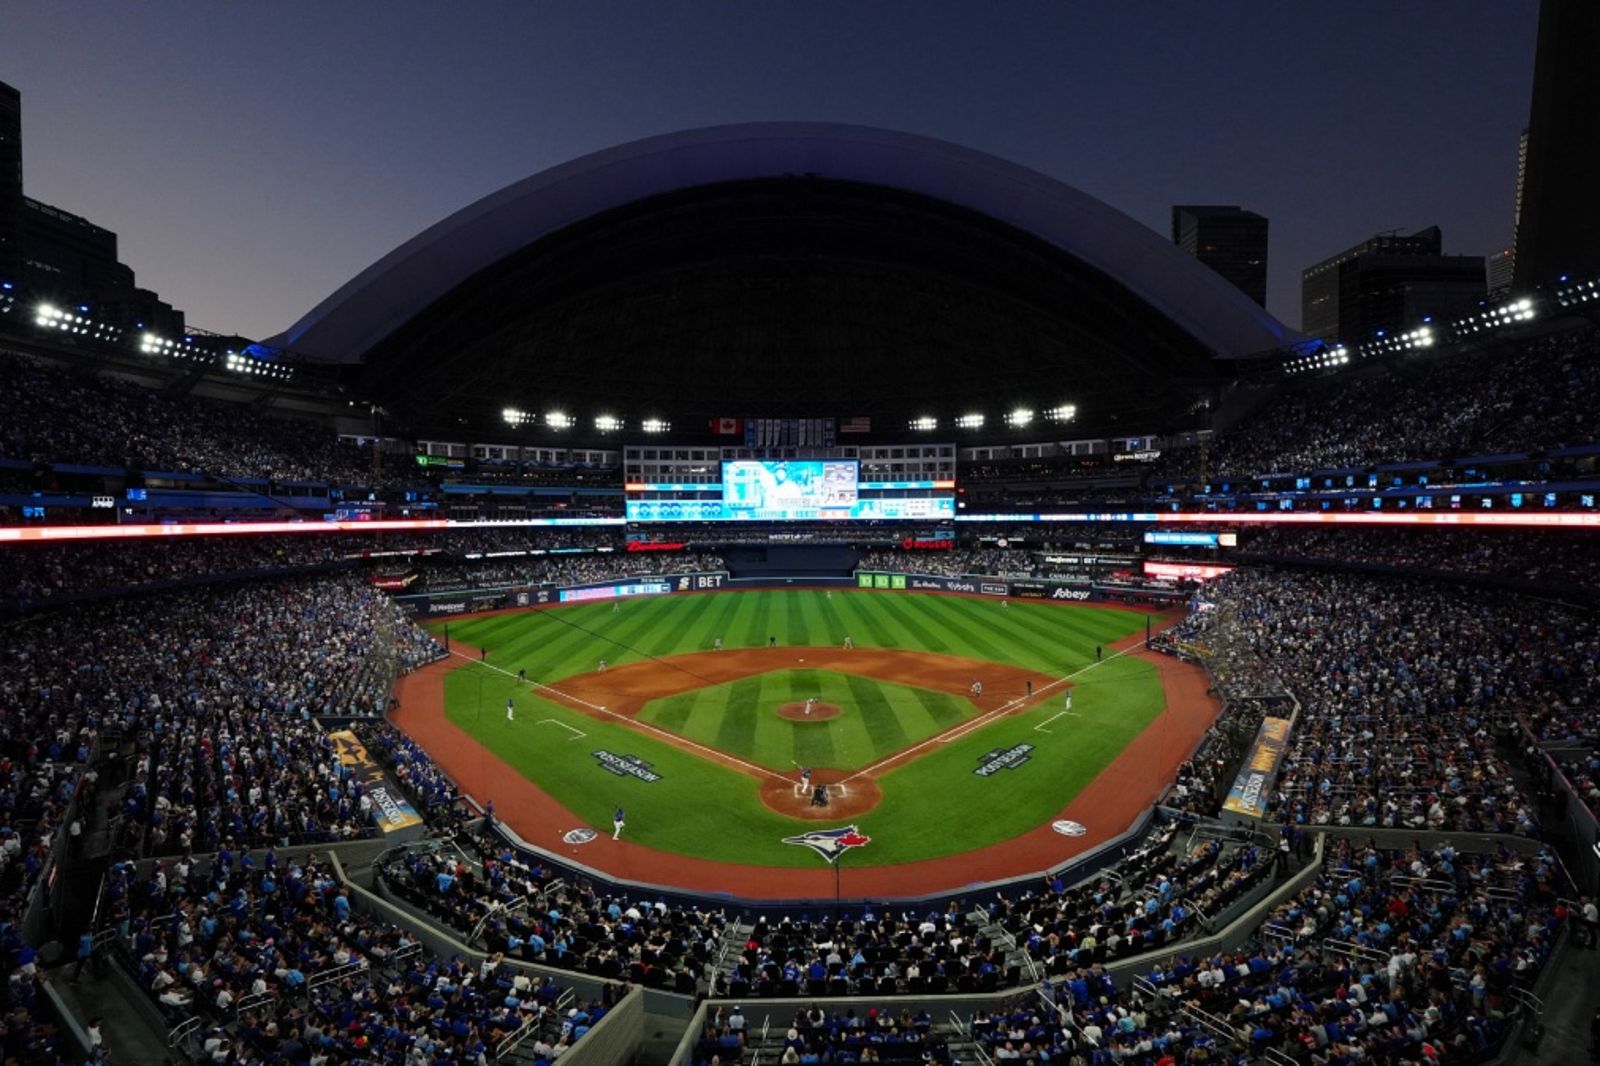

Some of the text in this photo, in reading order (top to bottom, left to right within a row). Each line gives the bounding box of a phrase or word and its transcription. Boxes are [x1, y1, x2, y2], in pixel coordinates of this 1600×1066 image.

[1134, 451, 1161, 461] ROOFTOP
[914, 540, 954, 549] ROGERS
[698, 576, 722, 588] BET
[1052, 588, 1090, 600] Sobeys
[594, 750, 660, 782] POSTSEASON
